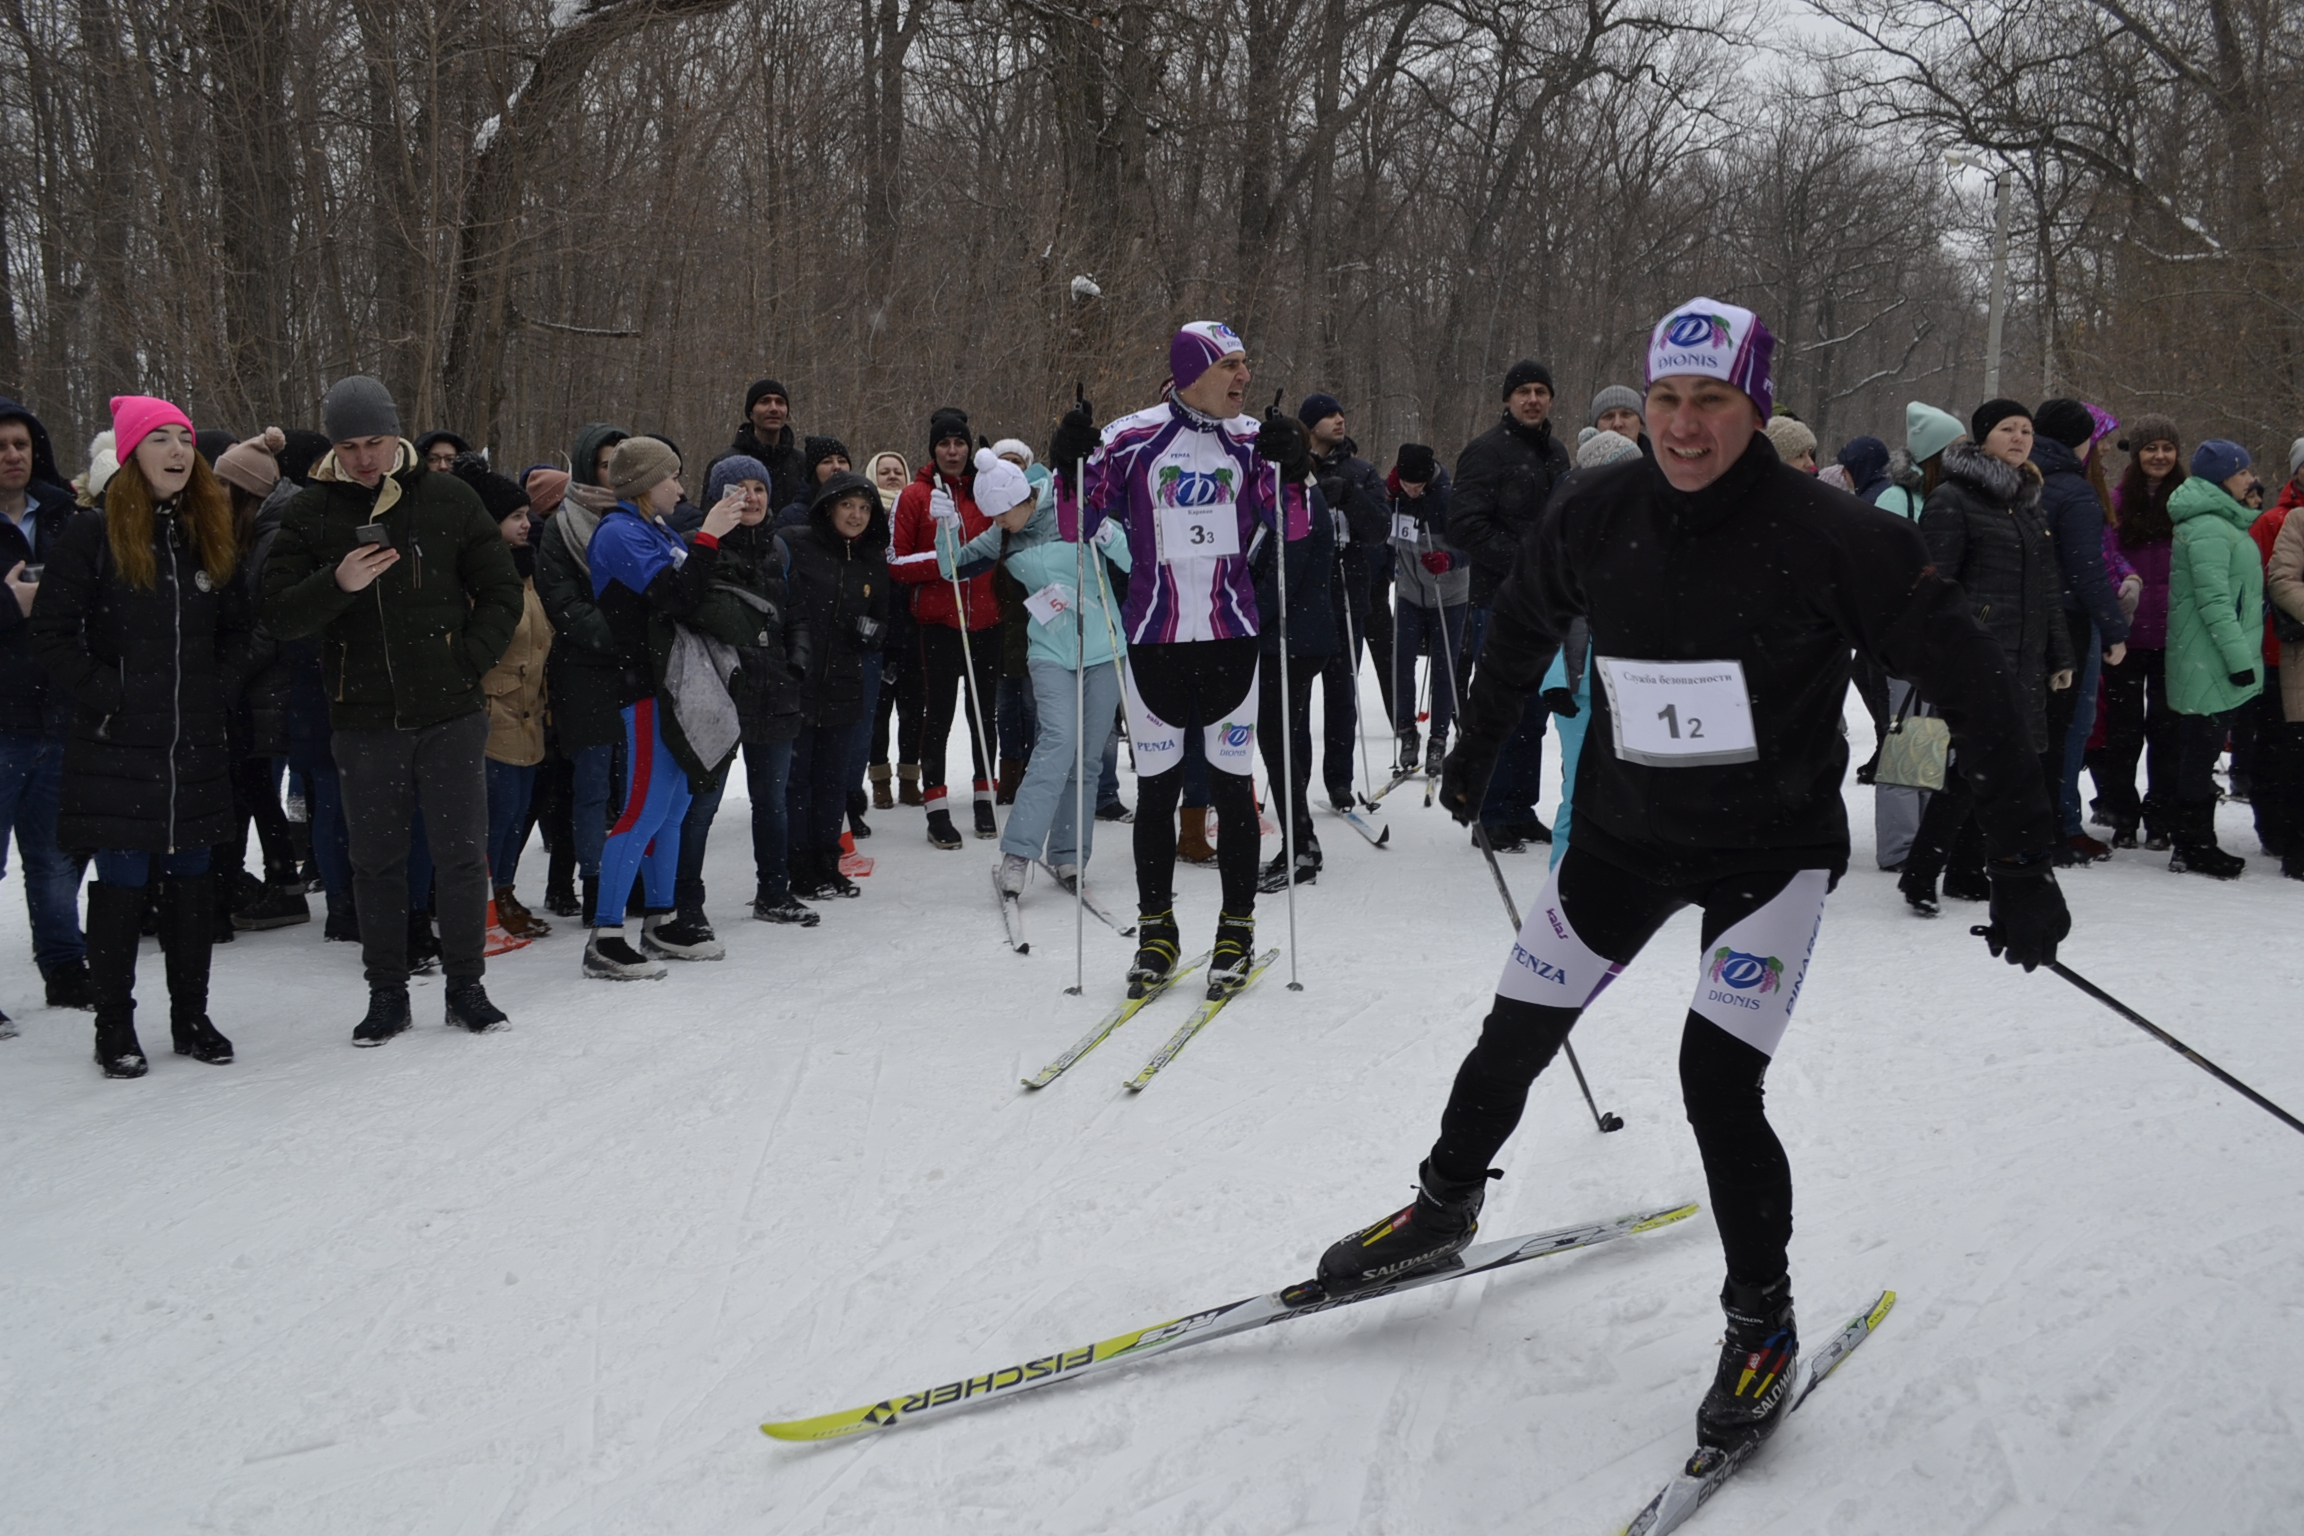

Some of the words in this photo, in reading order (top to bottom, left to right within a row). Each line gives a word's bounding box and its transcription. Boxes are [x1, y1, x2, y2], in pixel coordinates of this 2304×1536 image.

[1658, 352, 1719, 370] DIONIS
[1623, 671, 1658, 685] Служба
[1659, 674, 1733, 685] безопасности
[1137, 738, 1176, 752] PENZA
[1219, 748, 1247, 757] DIONIS
[1511, 942, 1567, 986] PENZA
[1707, 989, 1761, 1011] DIONIS
[1361, 1240, 1457, 1282] SALOMON
[900, 1343, 1096, 1414] FISCHER
